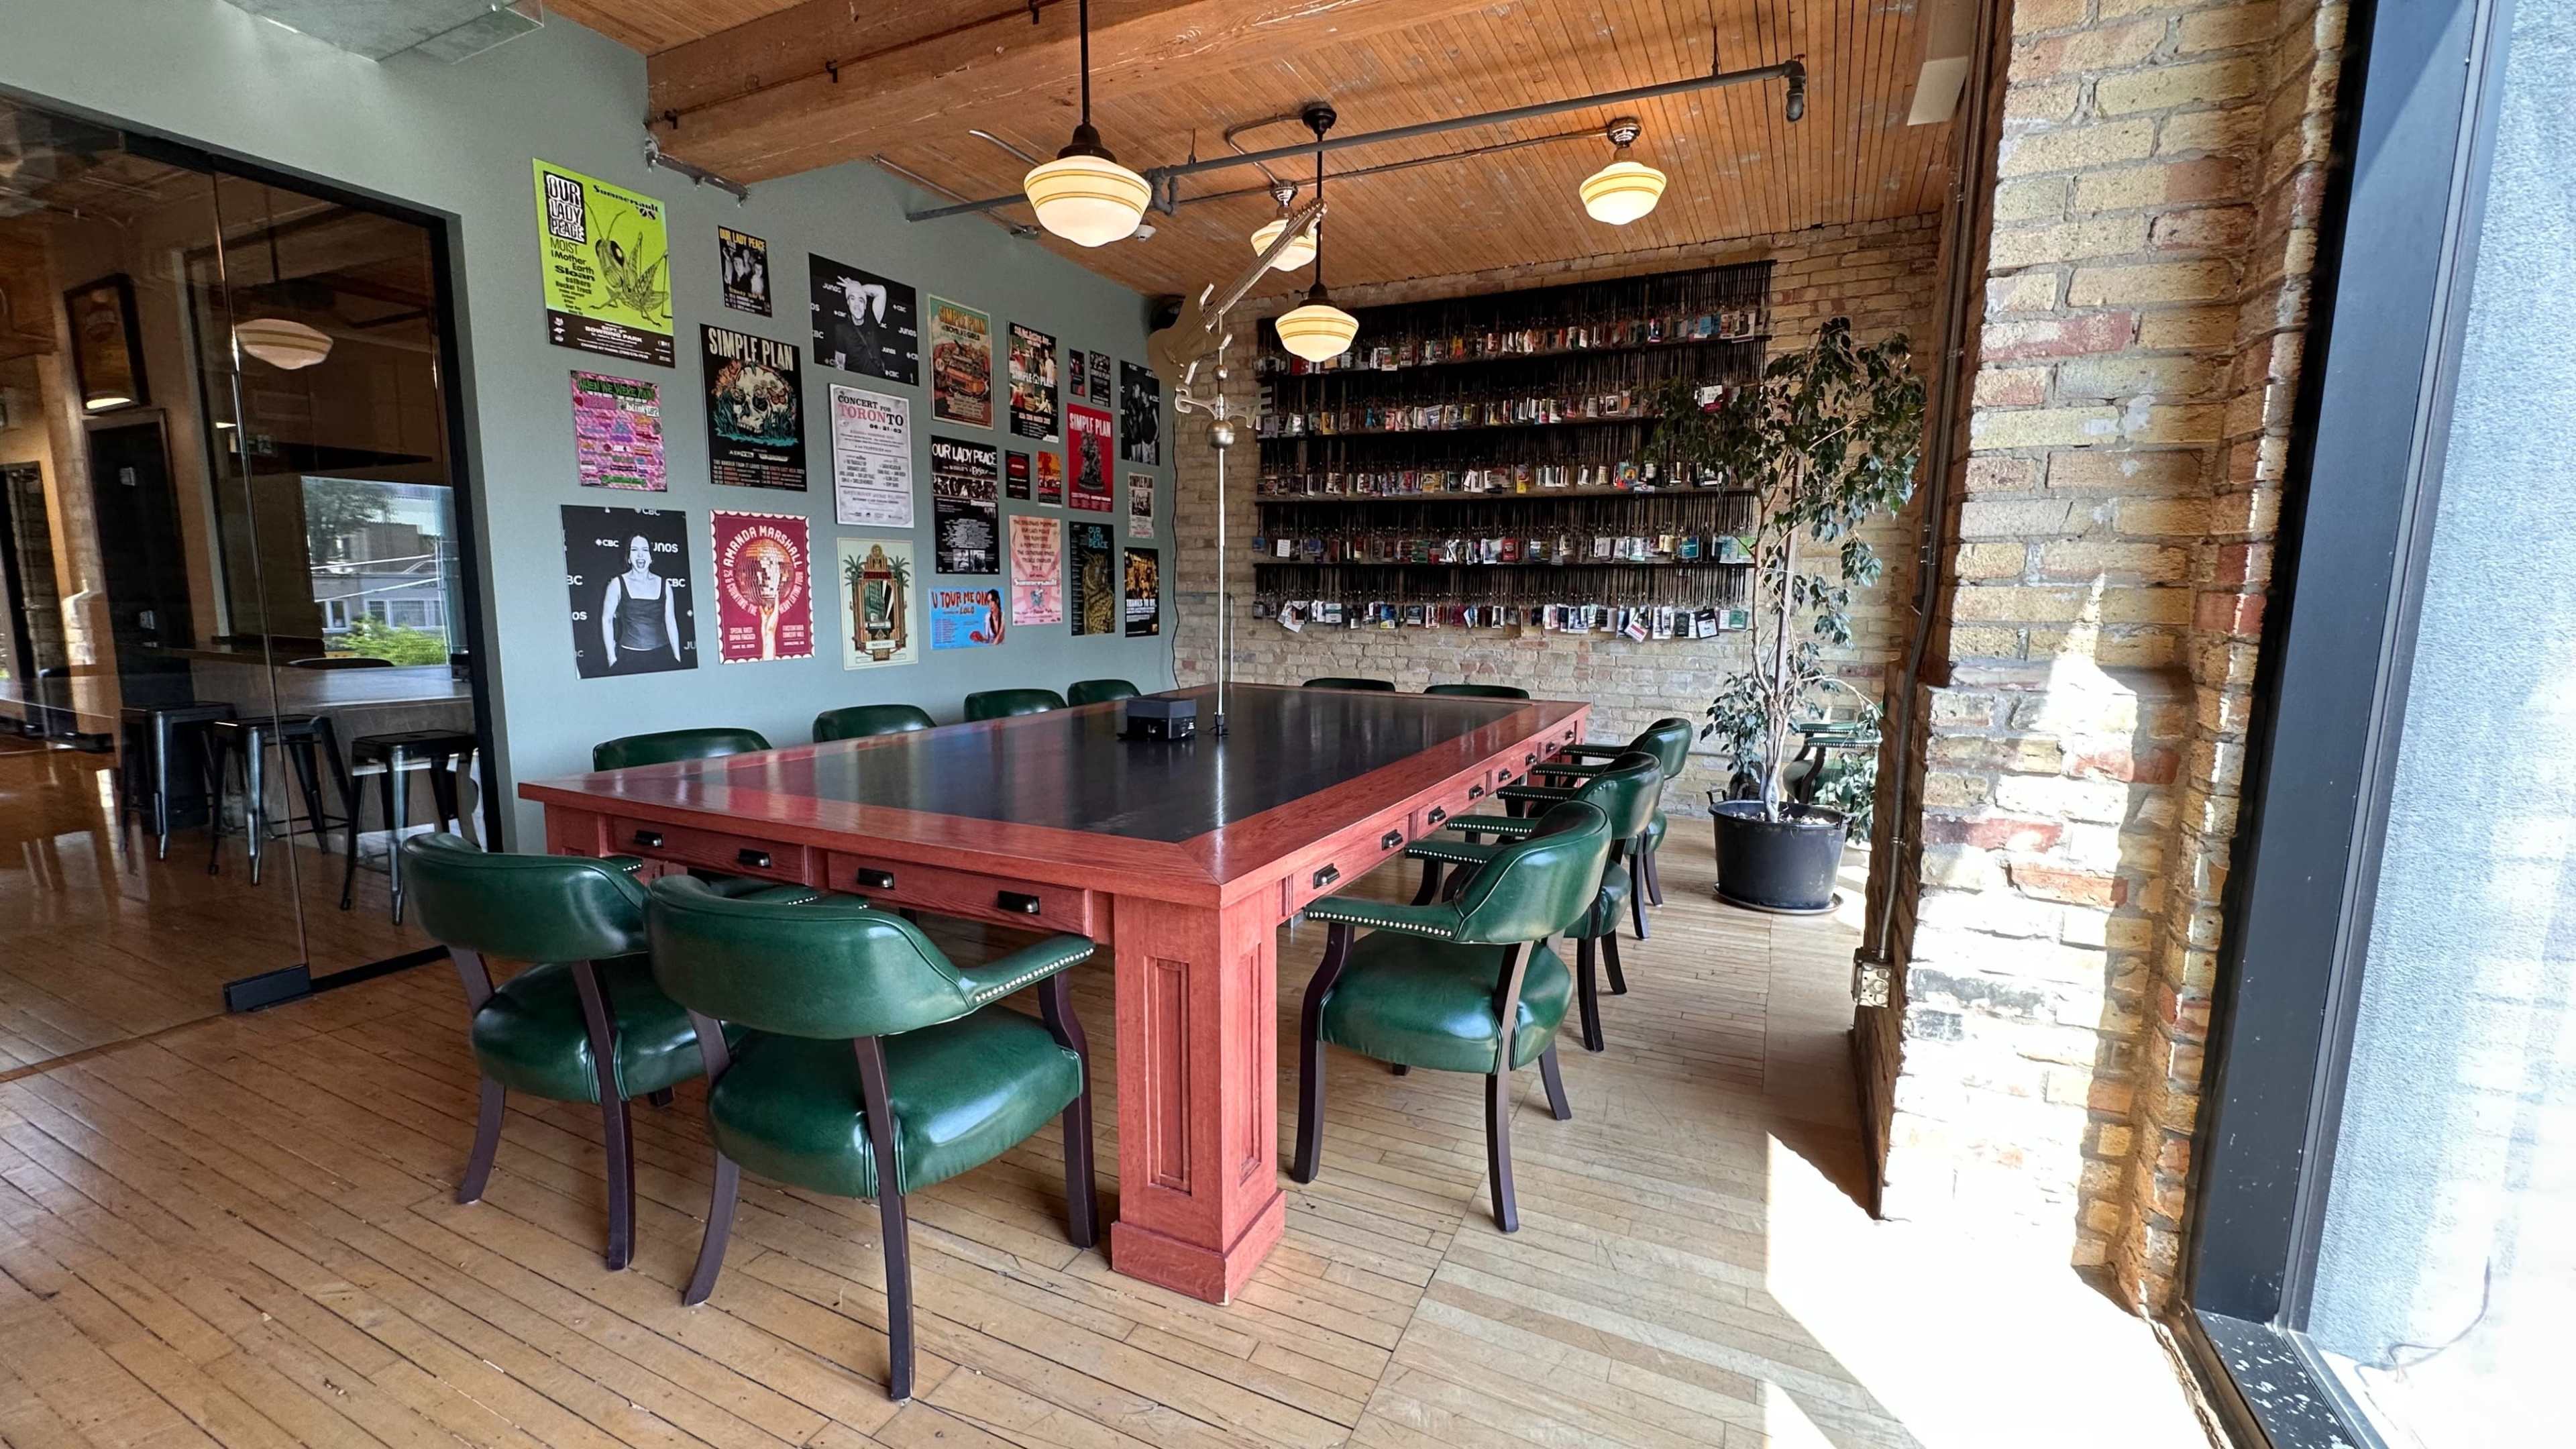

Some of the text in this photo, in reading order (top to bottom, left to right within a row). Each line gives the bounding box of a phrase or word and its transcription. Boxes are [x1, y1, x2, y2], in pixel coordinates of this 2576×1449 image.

[546, 174, 582, 207] OUR
[549, 198, 582, 226] LADY
[551, 218, 585, 243] PEACE
[550, 237, 579, 254] MOIST
[555, 251, 587, 265] Mother
[572, 262, 594, 275] Earth
[555, 265, 595, 282] Sloan
[708, 327, 757, 363] SIMPLE
[761, 339, 794, 372] PLAN
[838, 394, 878, 409] CONCERT
[838, 404, 904, 427] TORONTO
[1069, 413, 1093, 434] SIMPLE
[1095, 419, 1111, 437] PLAN
[932, 443, 997, 466] OUR LADY PEACE
[602, 539, 620, 547] CBC
[723, 525, 804, 569] AMANDA MARSHALL
[931, 591, 938, 609] U
[940, 591, 961, 608] TOUR
[963, 591, 975, 604] ME
